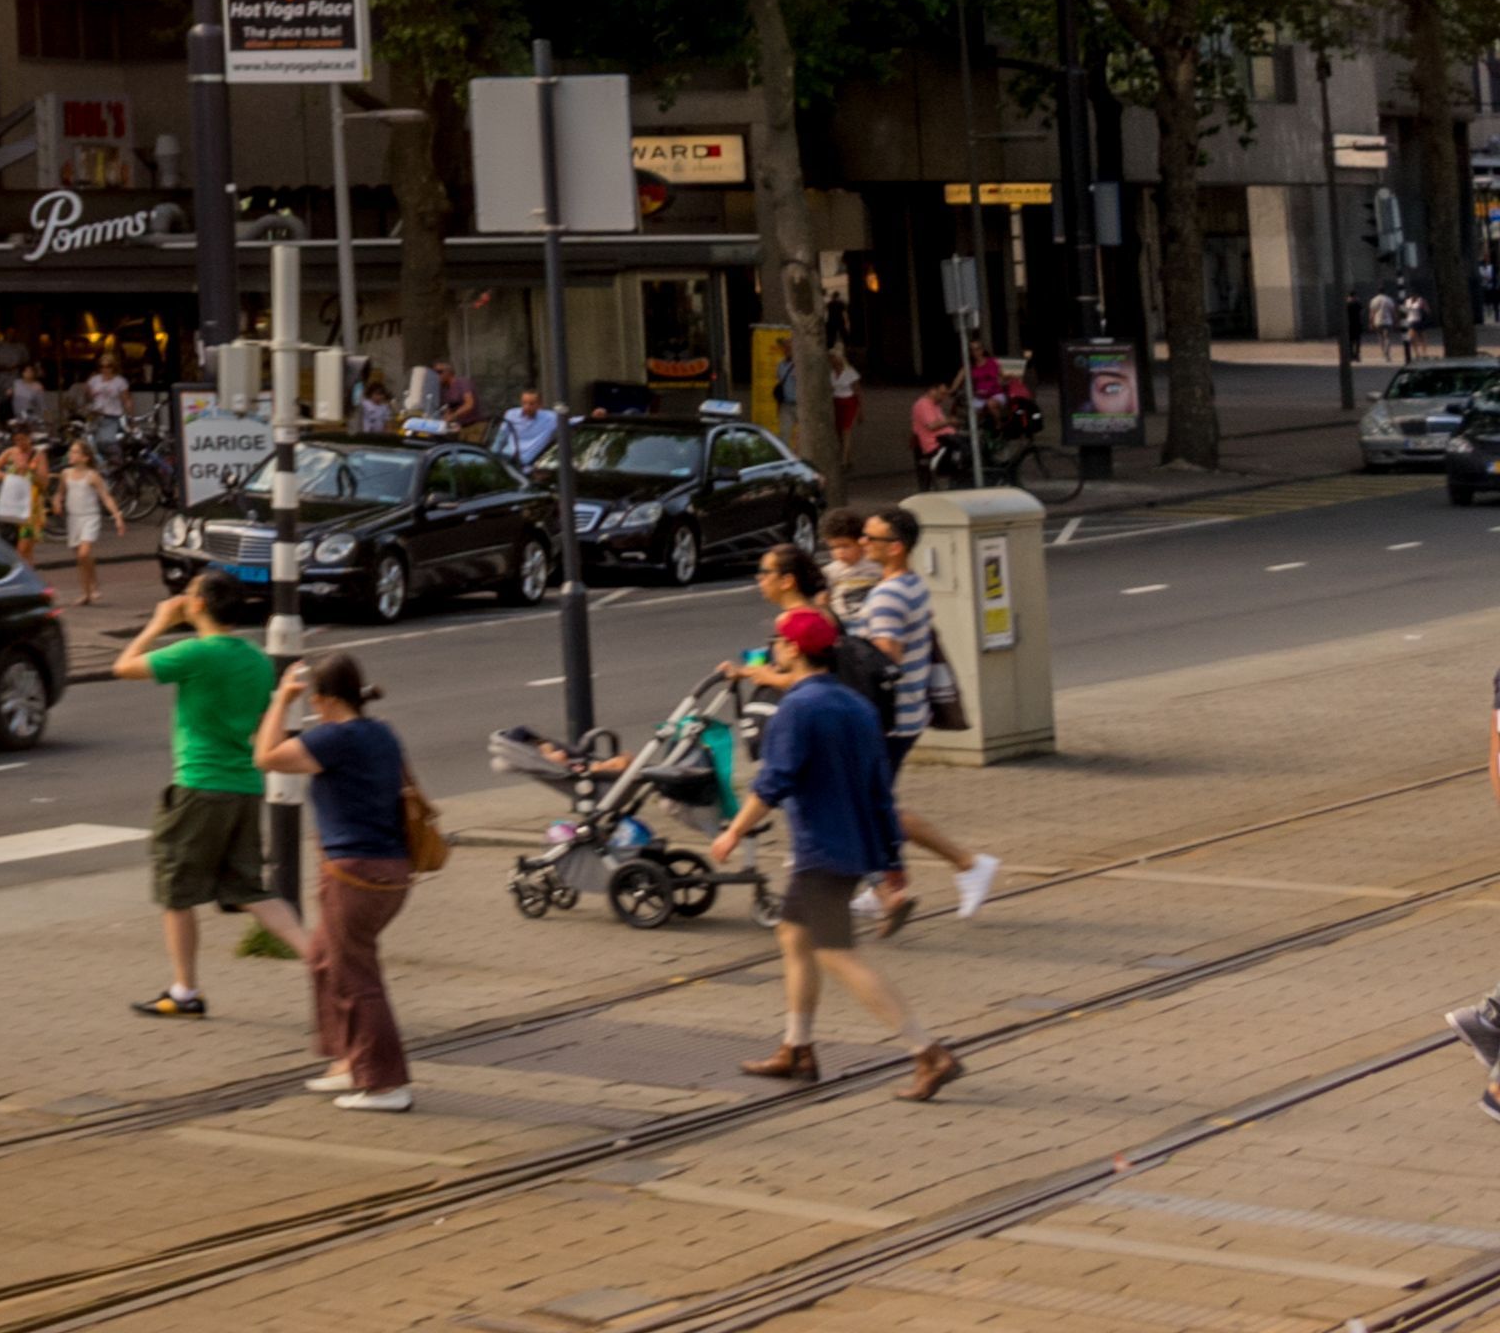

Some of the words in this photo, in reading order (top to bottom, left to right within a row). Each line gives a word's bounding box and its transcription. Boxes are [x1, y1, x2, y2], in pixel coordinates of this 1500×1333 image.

[230, 0, 262, 19] Hot
[263, 1, 306, 23] Yoga
[307, 0, 354, 18] Place
[243, 25, 268, 39] The
[269, 25, 303, 40] place
[304, 25, 321, 38] to
[632, 145, 710, 160] WARD
[190, 434, 267, 452] JARIGE
